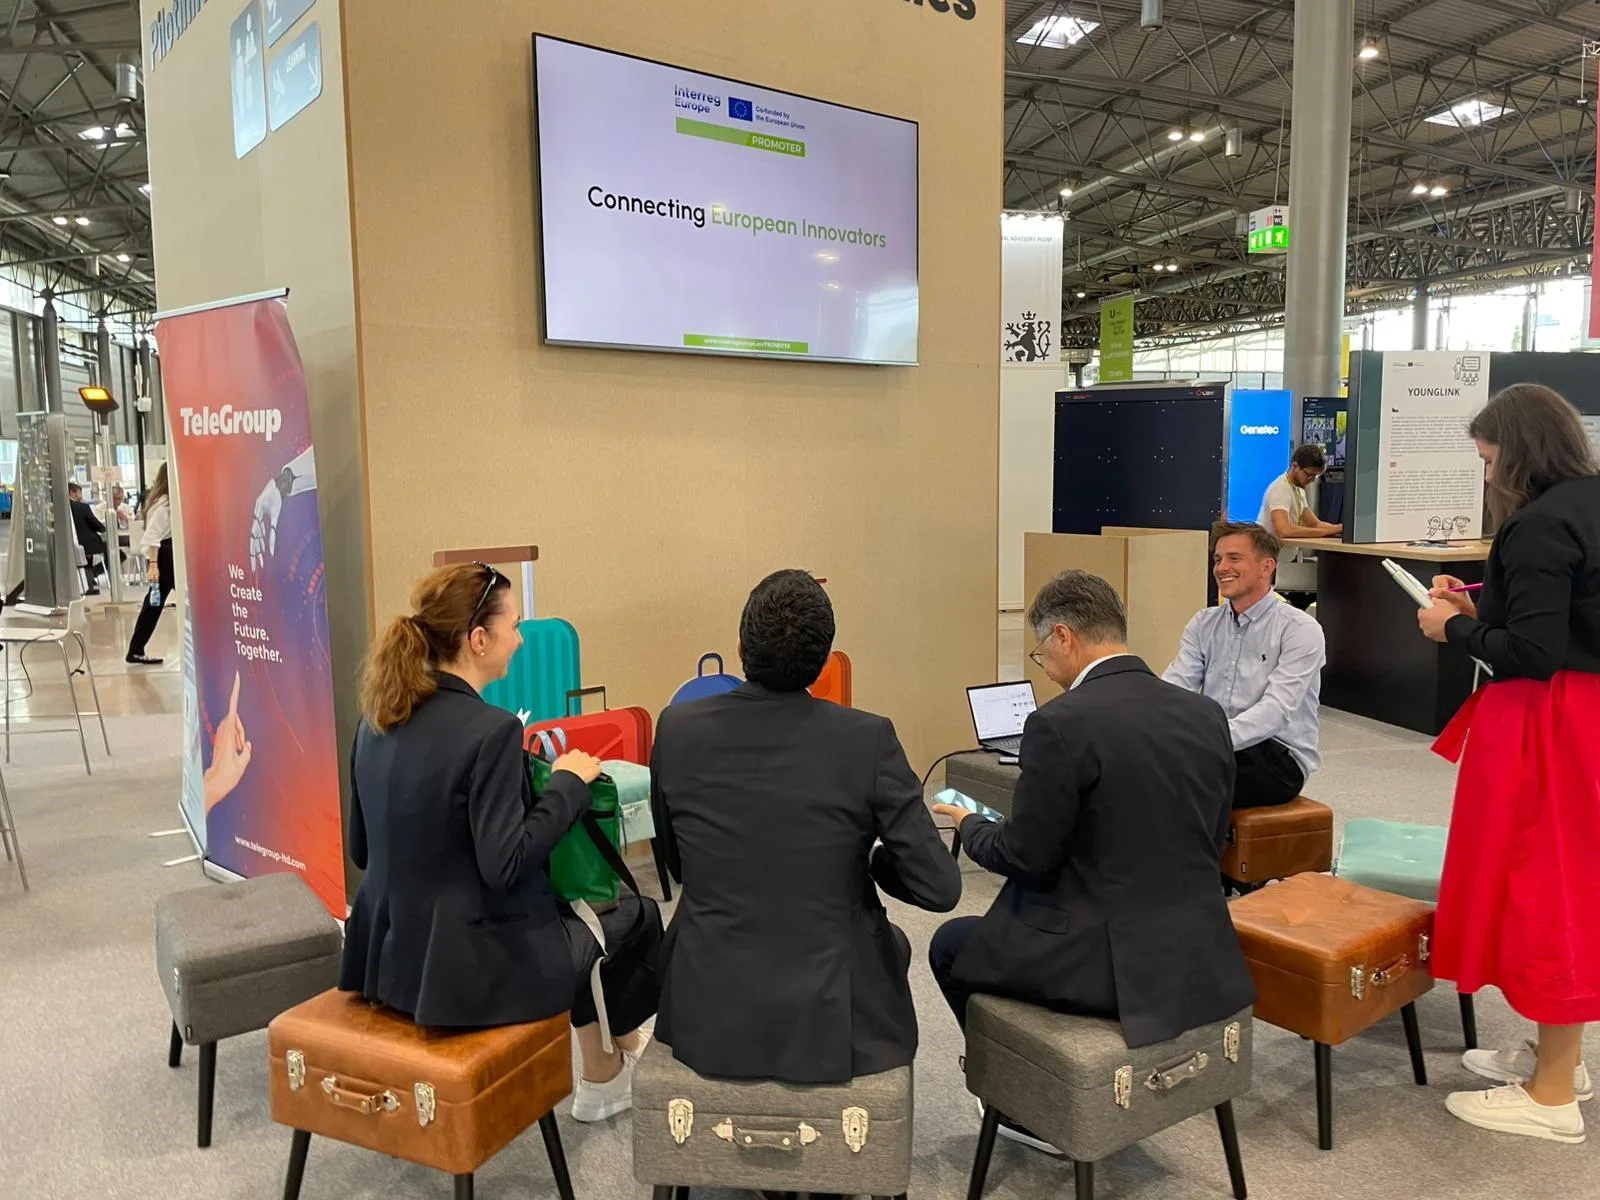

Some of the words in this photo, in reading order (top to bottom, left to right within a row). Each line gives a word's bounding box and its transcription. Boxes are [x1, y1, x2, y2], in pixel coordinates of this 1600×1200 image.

[674, 84, 721, 107] Interreg
[674, 98, 711, 114] Europe
[755, 106, 783, 117] Co-funded
[783, 112, 790, 120] by
[765, 116, 790, 127] European
[790, 121, 805, 130] Union
[751, 135, 802, 153] PROMOTER
[587, 185, 705, 228] Connecting
[711, 204, 798, 236] European
[802, 218, 887, 248] Innovators
[1408, 387, 1461, 397] YOUNGLINK
[180, 404, 282, 442] TeleGroup
[1239, 424, 1280, 435] Genetec
[228, 563, 245, 580] We
[230, 583, 263, 602] Create
[231, 603, 249, 619] the
[233, 621, 270, 641] Future.
[235, 640, 283, 663] Together.
[234, 834, 307, 872] www.telegroup-ltd.com
